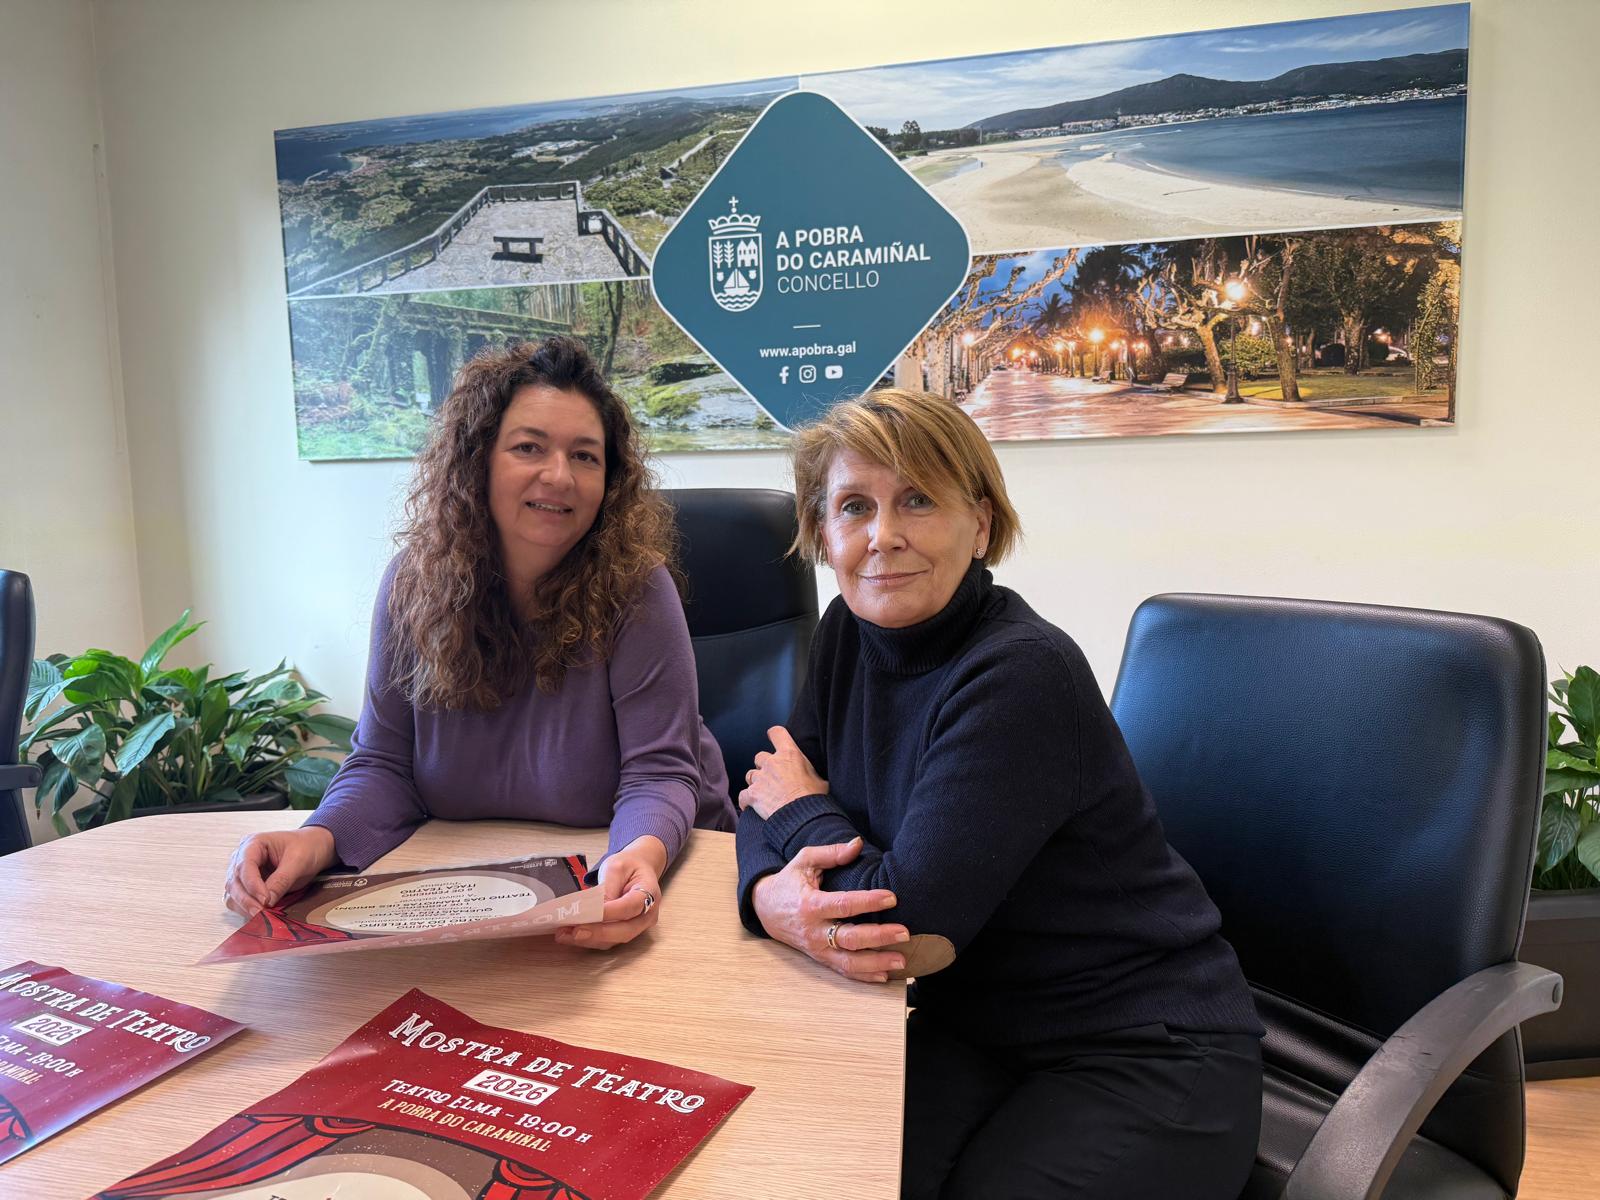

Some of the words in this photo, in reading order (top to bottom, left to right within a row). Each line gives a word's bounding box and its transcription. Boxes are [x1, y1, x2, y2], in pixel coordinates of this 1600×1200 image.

[776, 231, 790, 249] A
[795, 225, 864, 248] POBRA
[777, 254, 803, 271] DO
[809, 241, 931, 269] CARAMIÑAL
[777, 270, 880, 294] CONCELLO
[759, 340, 857, 358] www.apobra.gal
[0, 973, 90, 1012] MOSTRA
[76, 1002, 124, 1021] DE
[106, 1008, 211, 1053] TEATRO
[22, 1018, 82, 1041] 2026
[26, 1052, 76, 1073] 19:00
[65, 1068, 84, 1078] H
[389, 1013, 522, 1066] MOSTRA
[522, 1057, 574, 1079] DE
[571, 1065, 705, 1114] TEATRO
[476, 1074, 548, 1101] 2026
[381, 1079, 451, 1104] TEATRO
[447, 1095, 503, 1117] ELMA
[514, 1113, 577, 1138] 19:00
[575, 1133, 593, 1144] H
[377, 1099, 395, 1109] A
[391, 1101, 441, 1122] POBRA
[438, 1114, 464, 1128] DO
[462, 1119, 552, 1152] CARAMIÑAL
